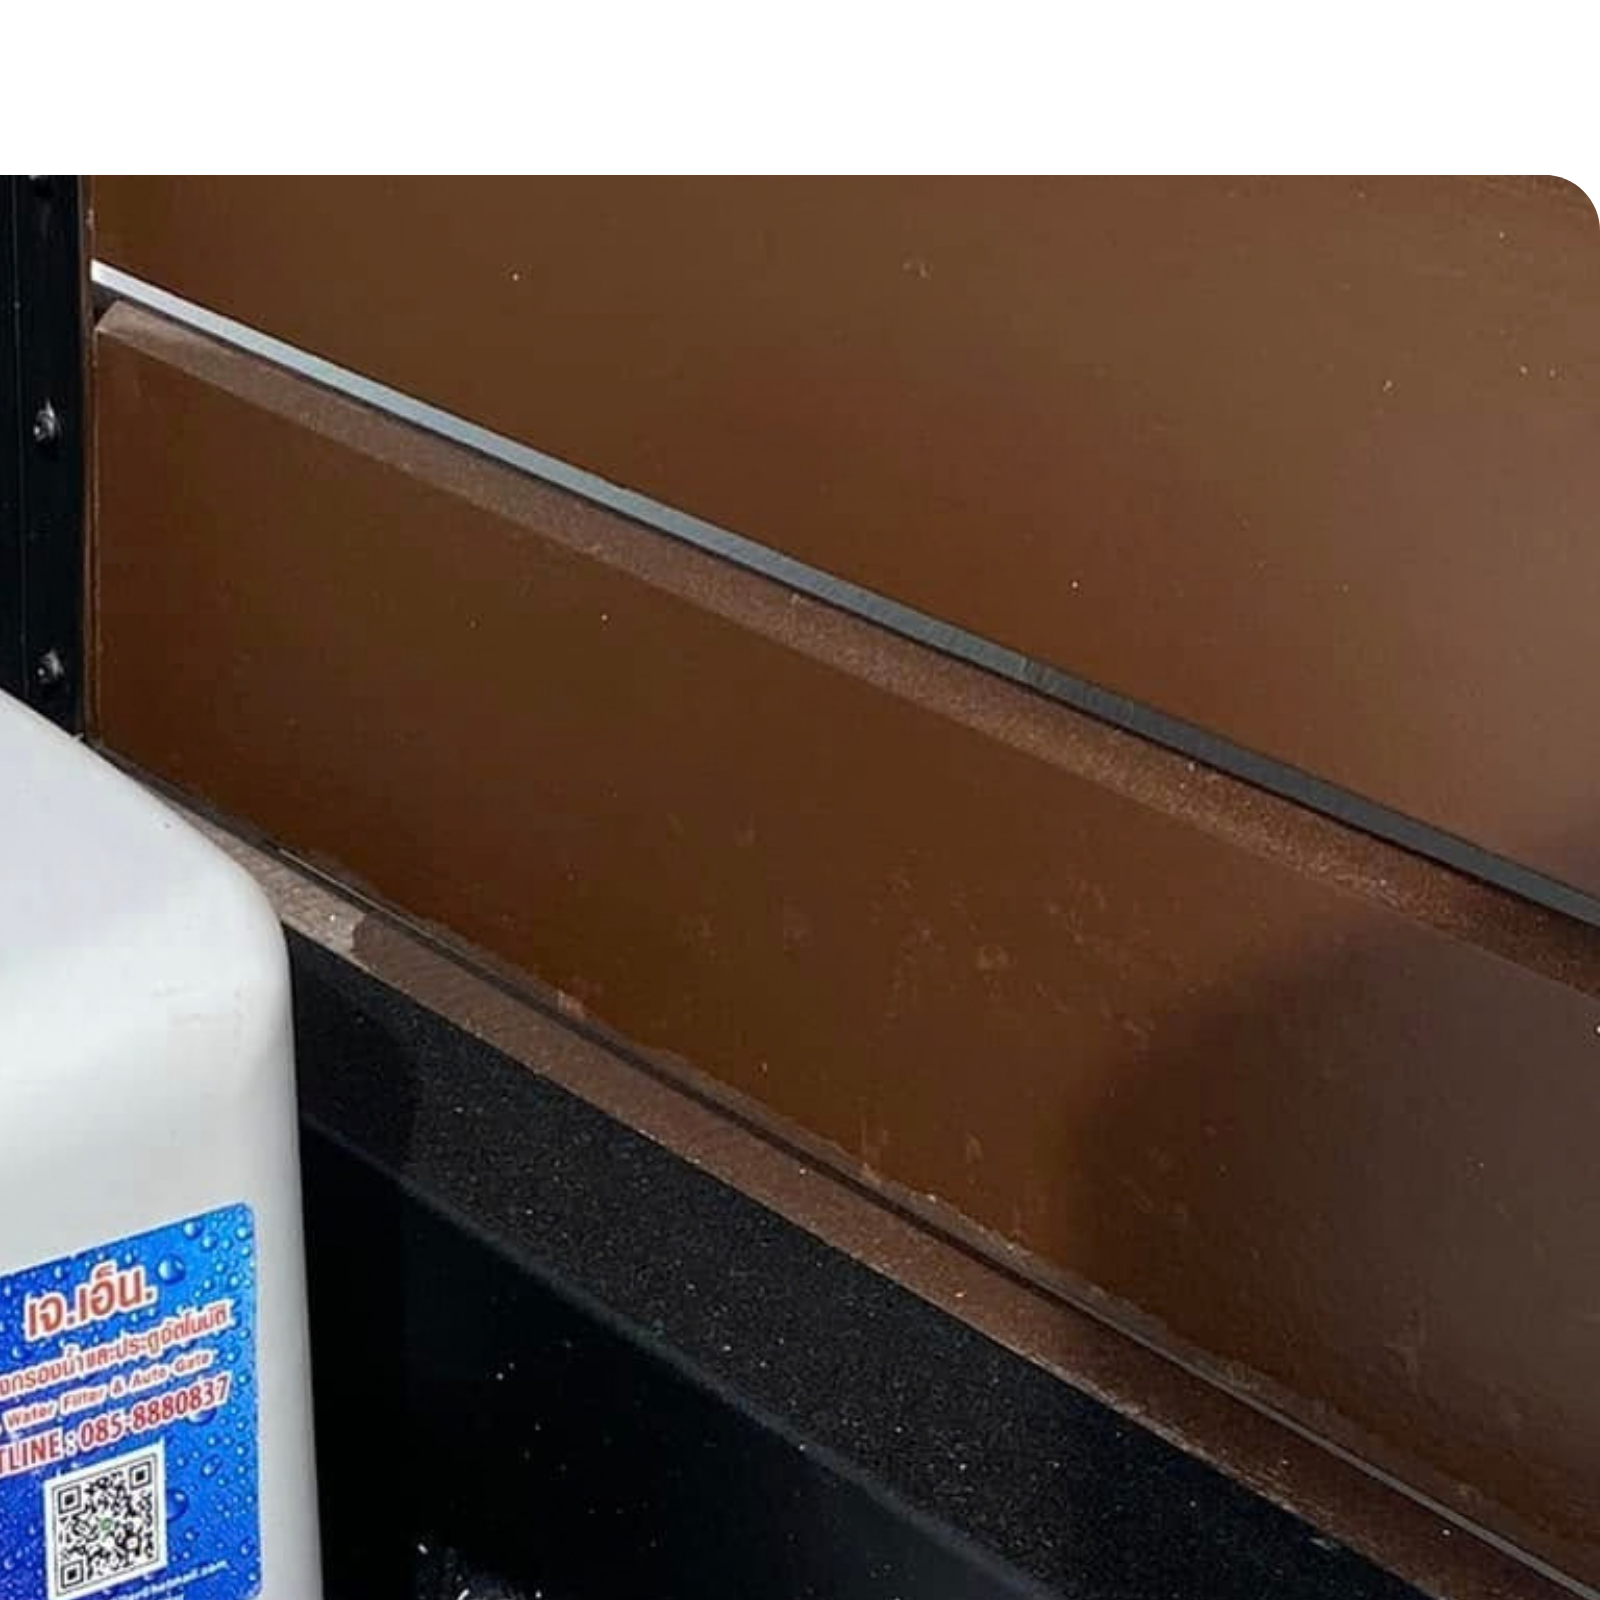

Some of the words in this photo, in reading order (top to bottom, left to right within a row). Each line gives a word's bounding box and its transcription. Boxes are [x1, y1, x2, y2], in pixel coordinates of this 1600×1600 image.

[25, 1258, 157, 1340] เจ.เอ็น.
[5, 1404, 55, 1428] Water
[62, 1388, 106, 1411] Filter
[132, 1365, 168, 1387] Auto
[174, 1352, 211, 1374] Gate
